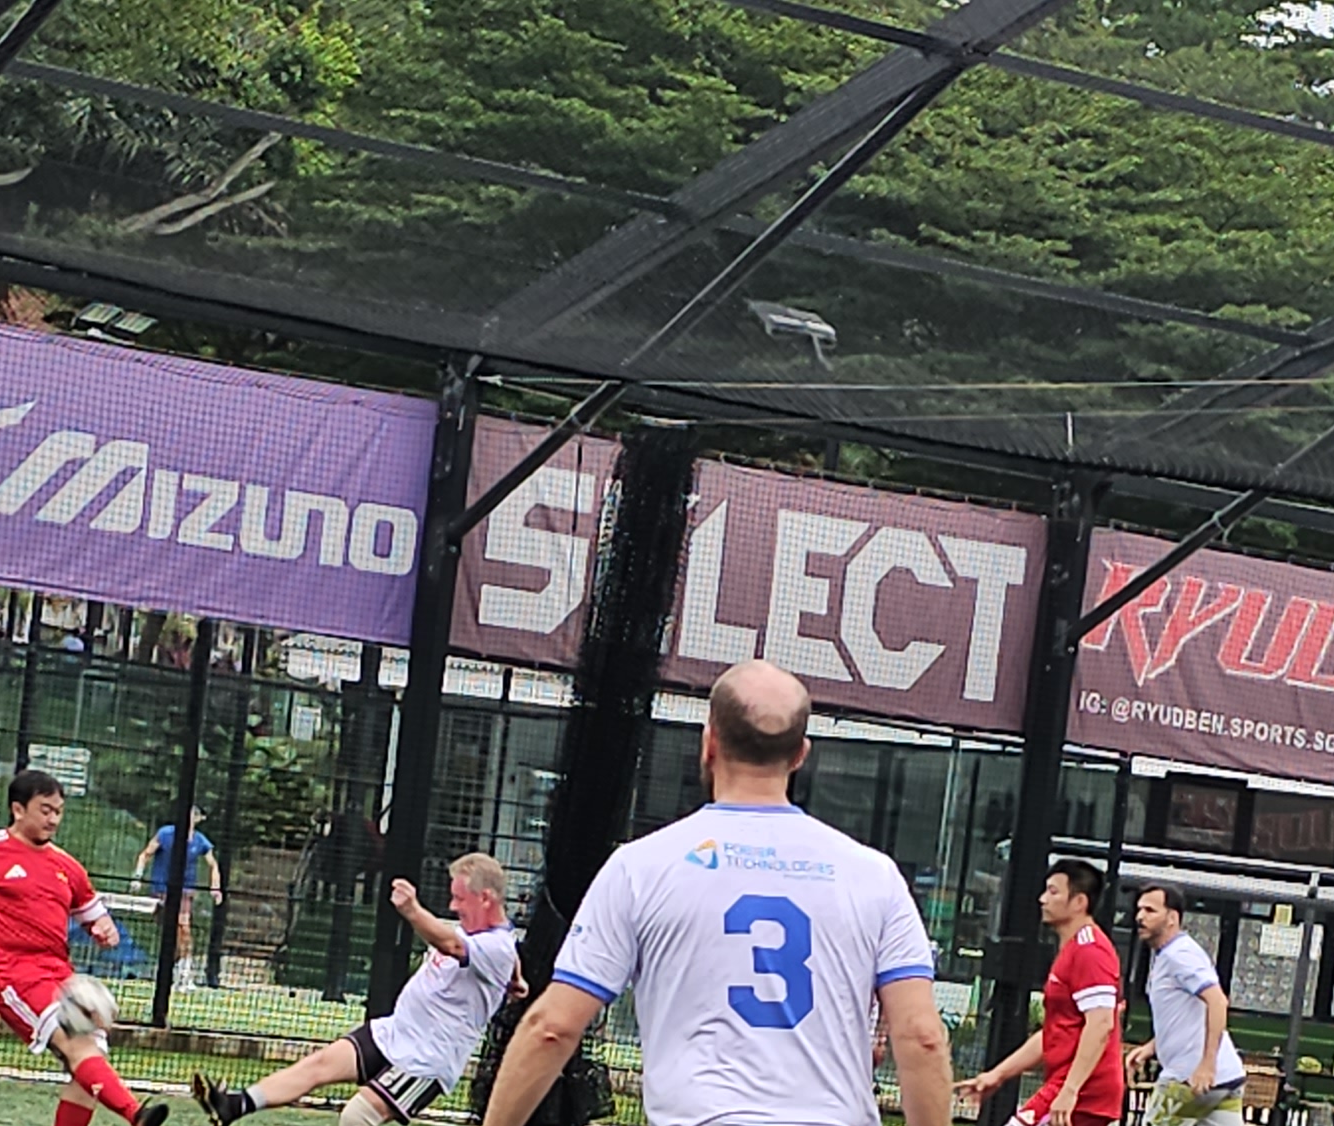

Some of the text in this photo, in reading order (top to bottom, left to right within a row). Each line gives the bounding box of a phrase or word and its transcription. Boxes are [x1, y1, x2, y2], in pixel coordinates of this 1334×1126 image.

[478, 466, 1028, 703] SLECT
[1079, 690, 1107, 714] IG:
[723, 894, 814, 1029] 3
